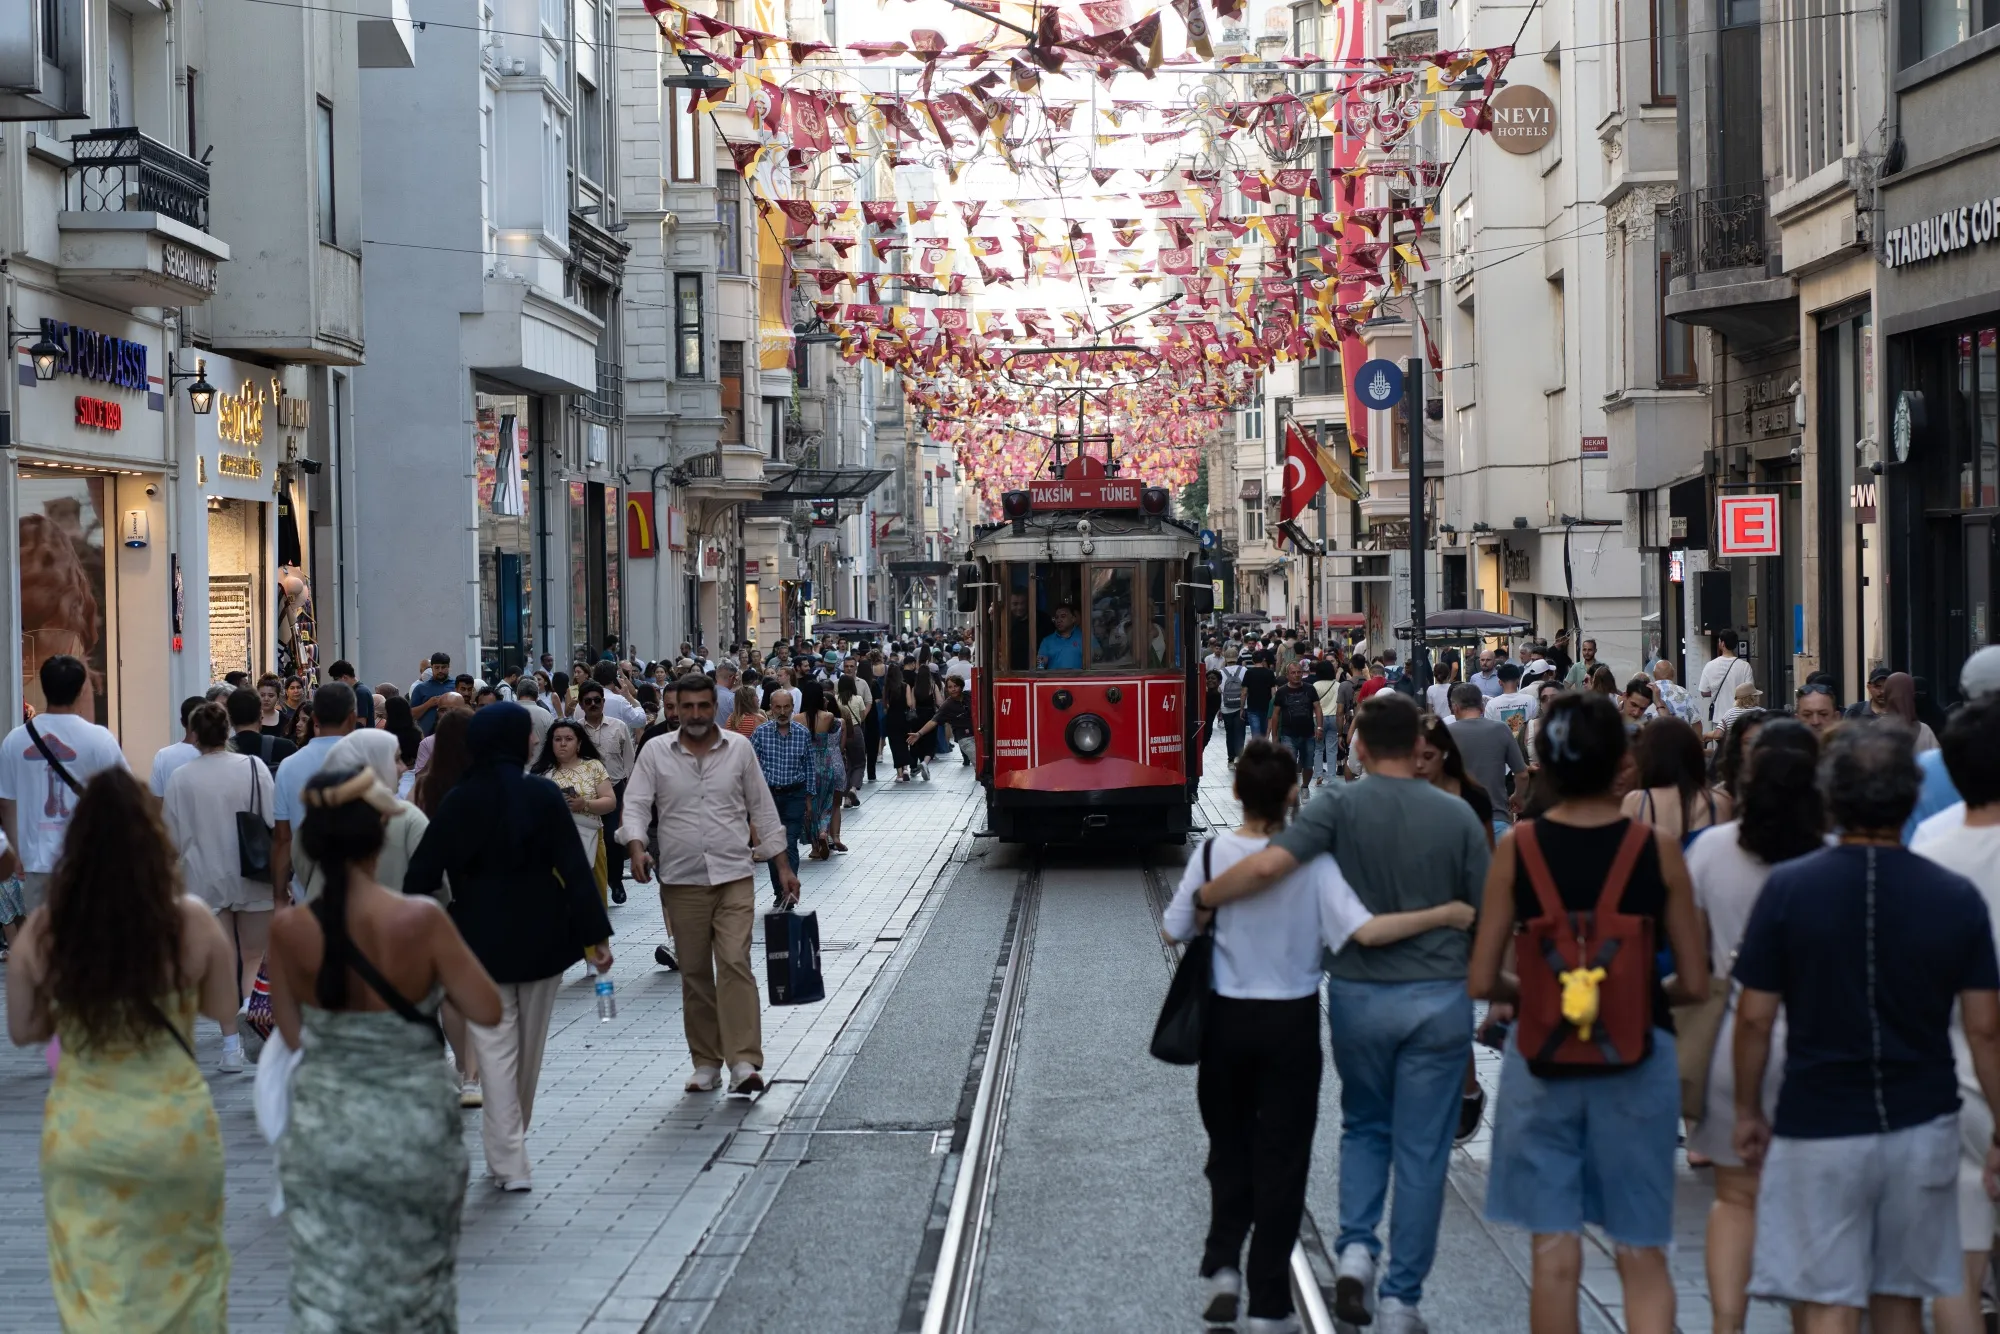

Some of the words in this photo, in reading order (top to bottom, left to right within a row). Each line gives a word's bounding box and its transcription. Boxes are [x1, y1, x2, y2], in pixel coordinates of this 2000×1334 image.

[803, 110, 818, 131] 25
[1493, 107, 1550, 123] NEVI
[1498, 127, 1548, 137] HOTELS
[1153, 195, 1167, 203] 25
[1886, 206, 1968, 269] STARBUCKS
[166, 244, 196, 284] SEKBAN
[195, 256, 209, 288] HAN
[77, 326, 114, 383] POLO
[116, 338, 150, 391] ASSN.
[79, 396, 104, 428] SINCE
[105, 401, 123, 431] 1890
[1081, 458, 1087, 477] 1
[1031, 484, 1073, 502] TAKSİM
[1100, 483, 1137, 502] TÜNEL
[1734, 507, 1764, 544] E
[1001, 698, 1012, 715] 47
[1162, 694, 1176, 711] 47
[1151, 746, 1157, 754] VE
